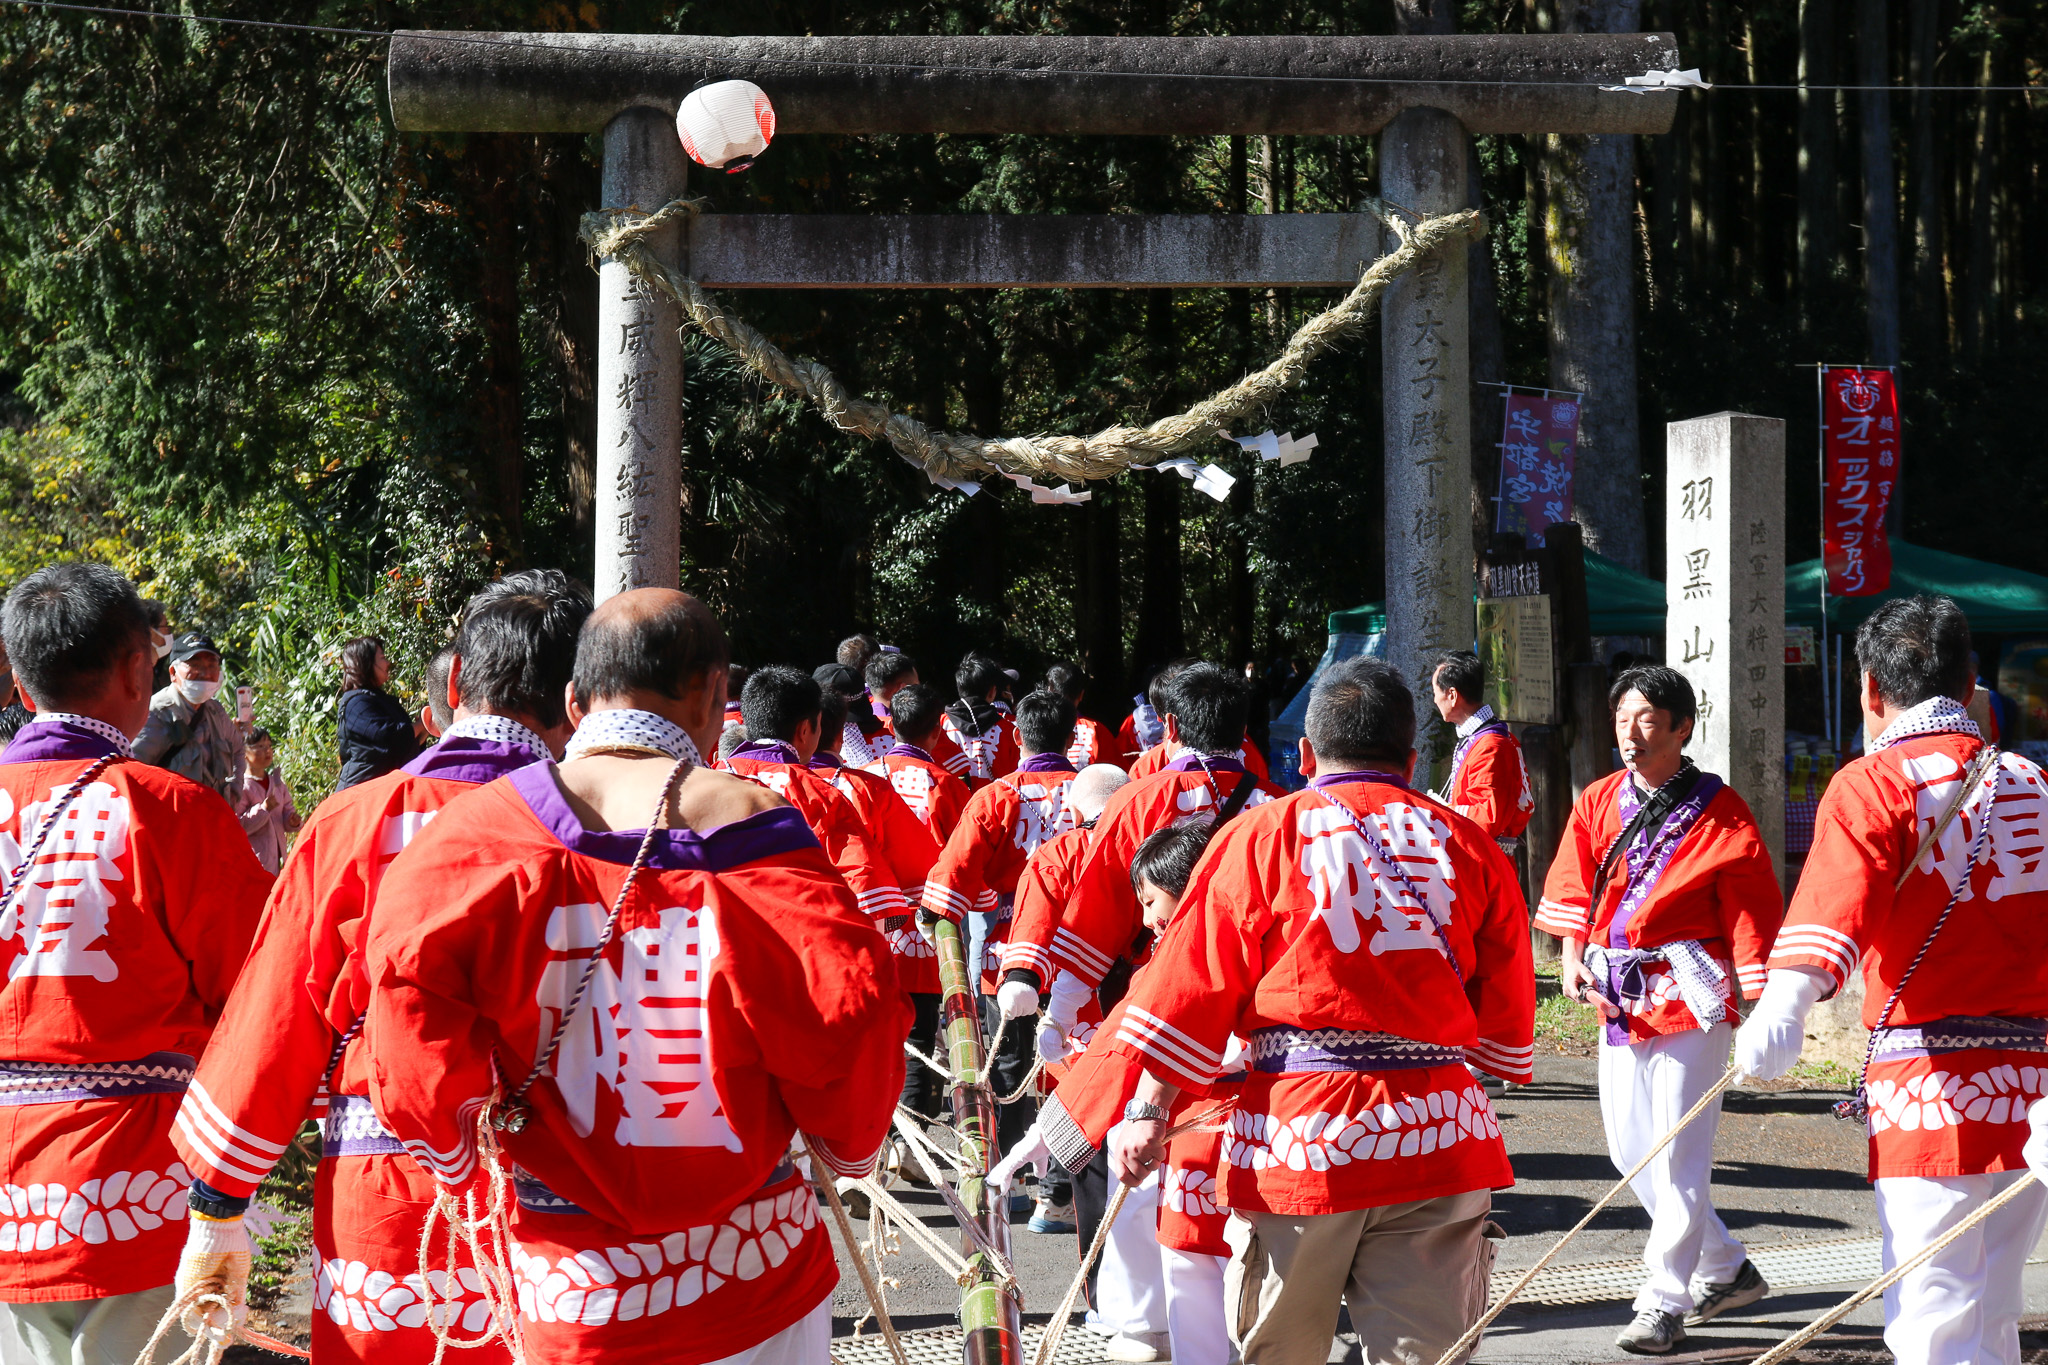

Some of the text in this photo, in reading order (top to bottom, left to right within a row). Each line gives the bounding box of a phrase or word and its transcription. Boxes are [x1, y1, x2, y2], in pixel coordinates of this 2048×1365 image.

[1836, 415, 1876, 592] オニックスジャパン
